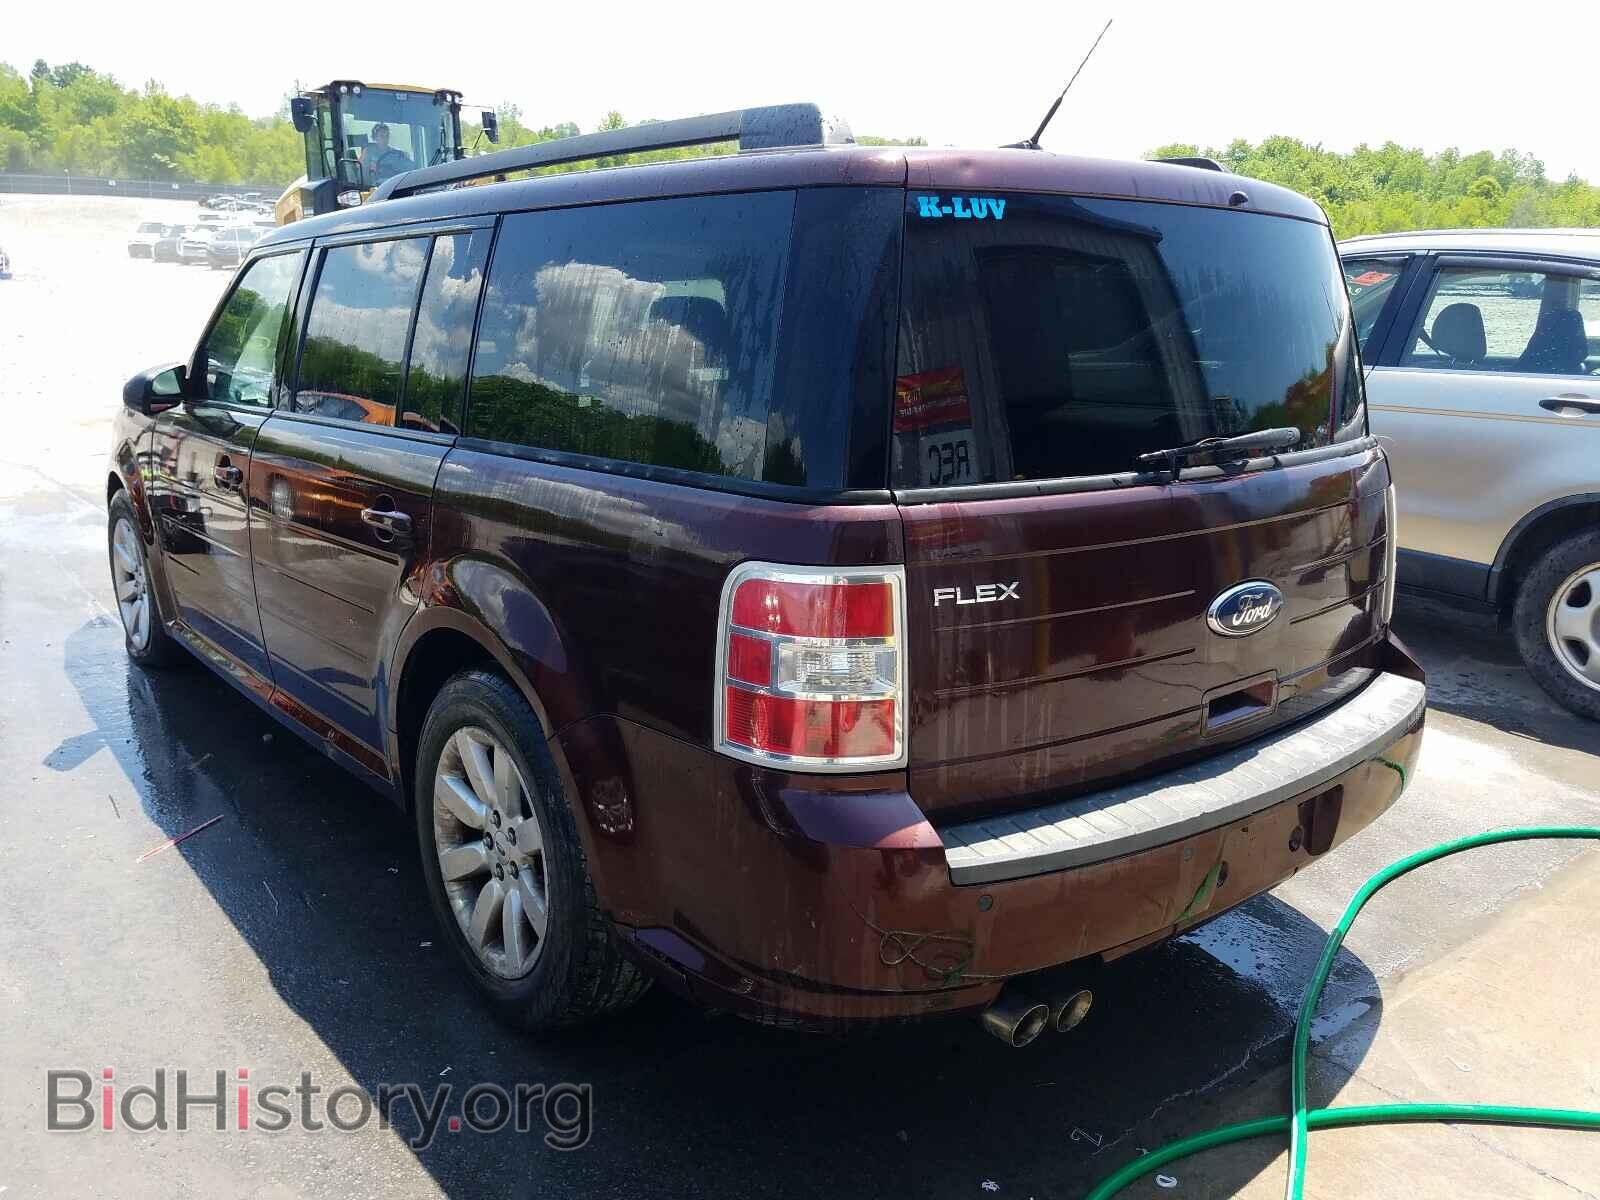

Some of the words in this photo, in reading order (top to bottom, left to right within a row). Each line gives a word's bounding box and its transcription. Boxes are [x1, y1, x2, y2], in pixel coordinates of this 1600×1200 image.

[917, 196, 1006, 220] K-LUV
[933, 581, 1020, 607] FLEX
[1232, 592, 1273, 626] Ford
